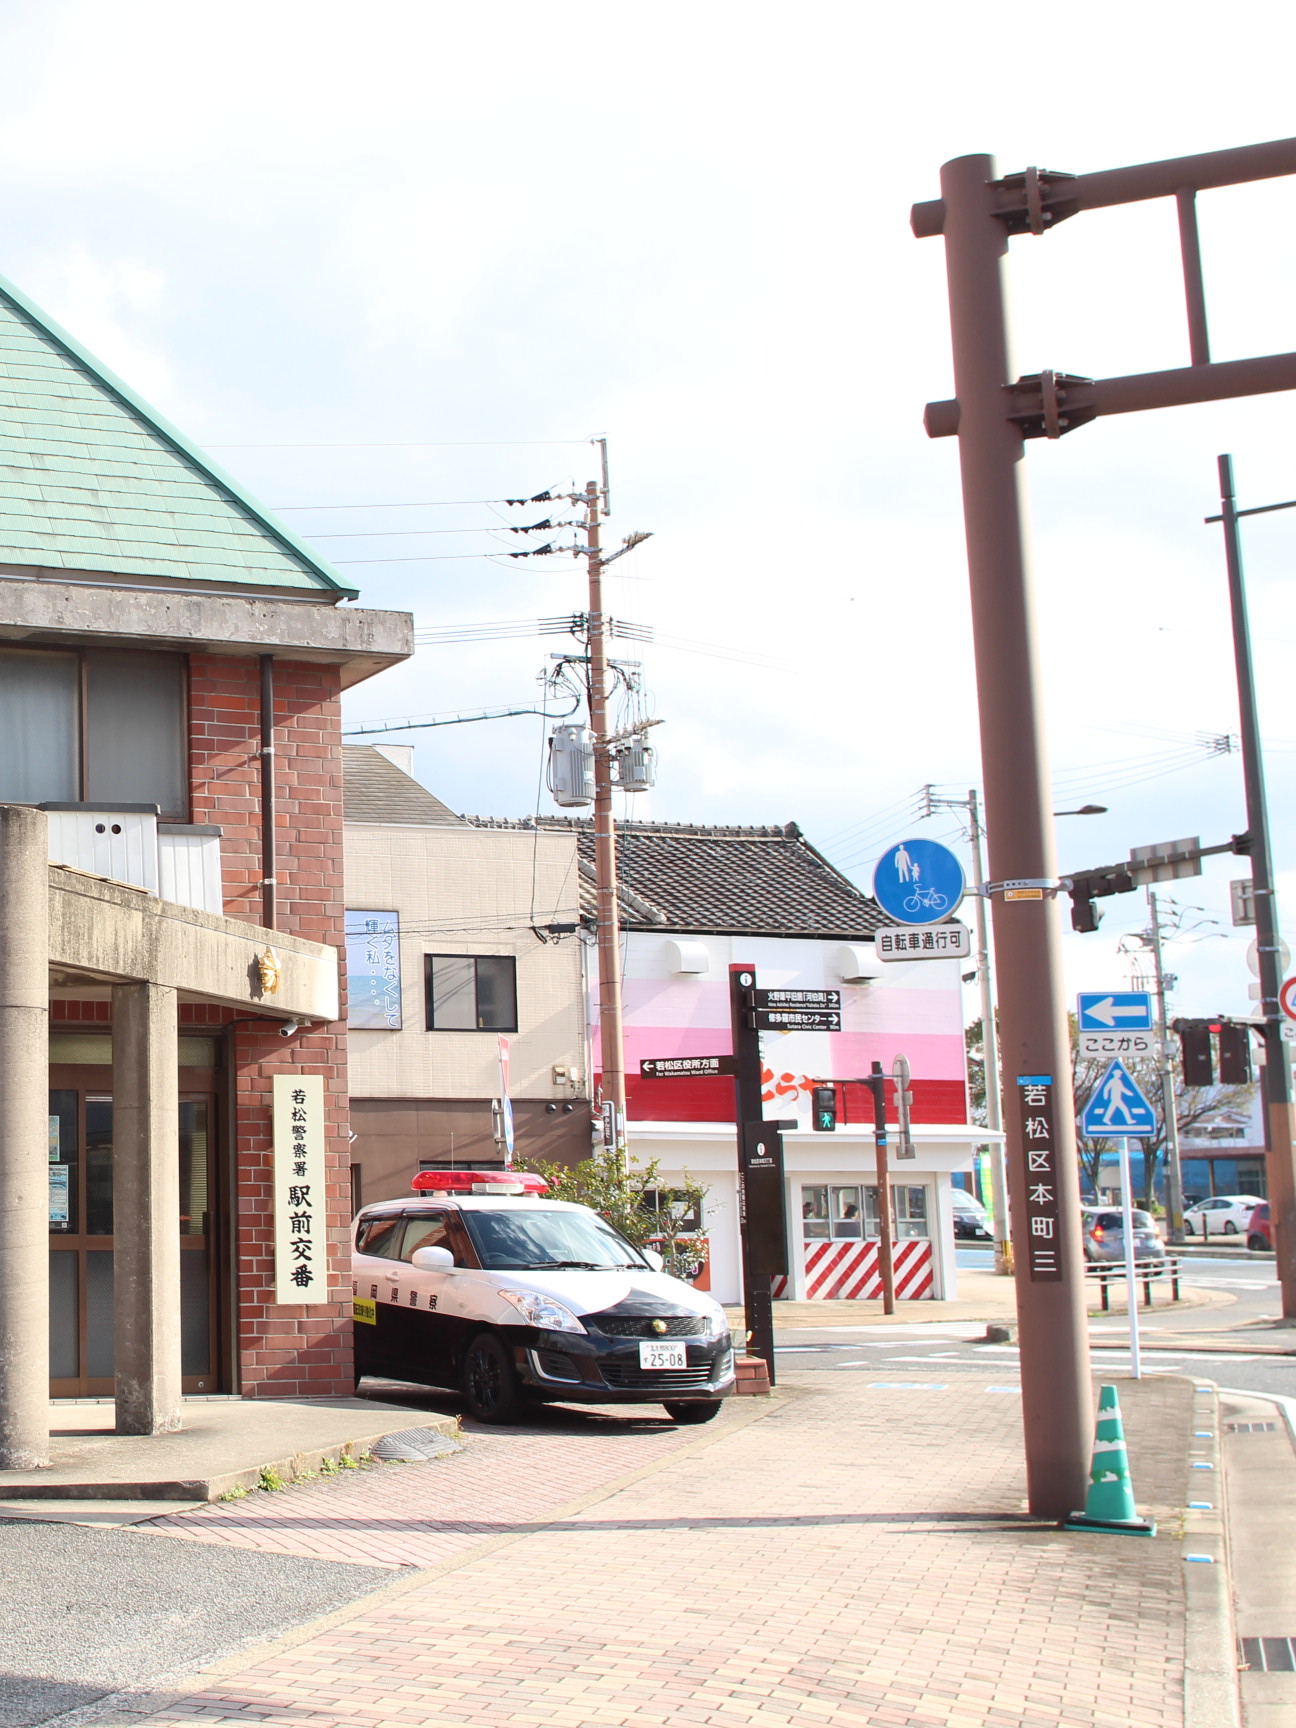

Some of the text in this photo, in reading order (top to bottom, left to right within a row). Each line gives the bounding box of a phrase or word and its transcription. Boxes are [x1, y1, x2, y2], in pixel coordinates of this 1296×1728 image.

[881, 931, 961, 952] 自転車通行可
[384, 921, 398, 1027] ムダをなくして
[1086, 1037, 1148, 1052] ここから
[655, 1058, 719, 1070] 若松区役所方面
[288, 1089, 314, 1288] 若松警察署 駅前交番
[1024, 1085, 1057, 1271] 若松区本町三
[650, 1353, 683, 1367] 25-08
